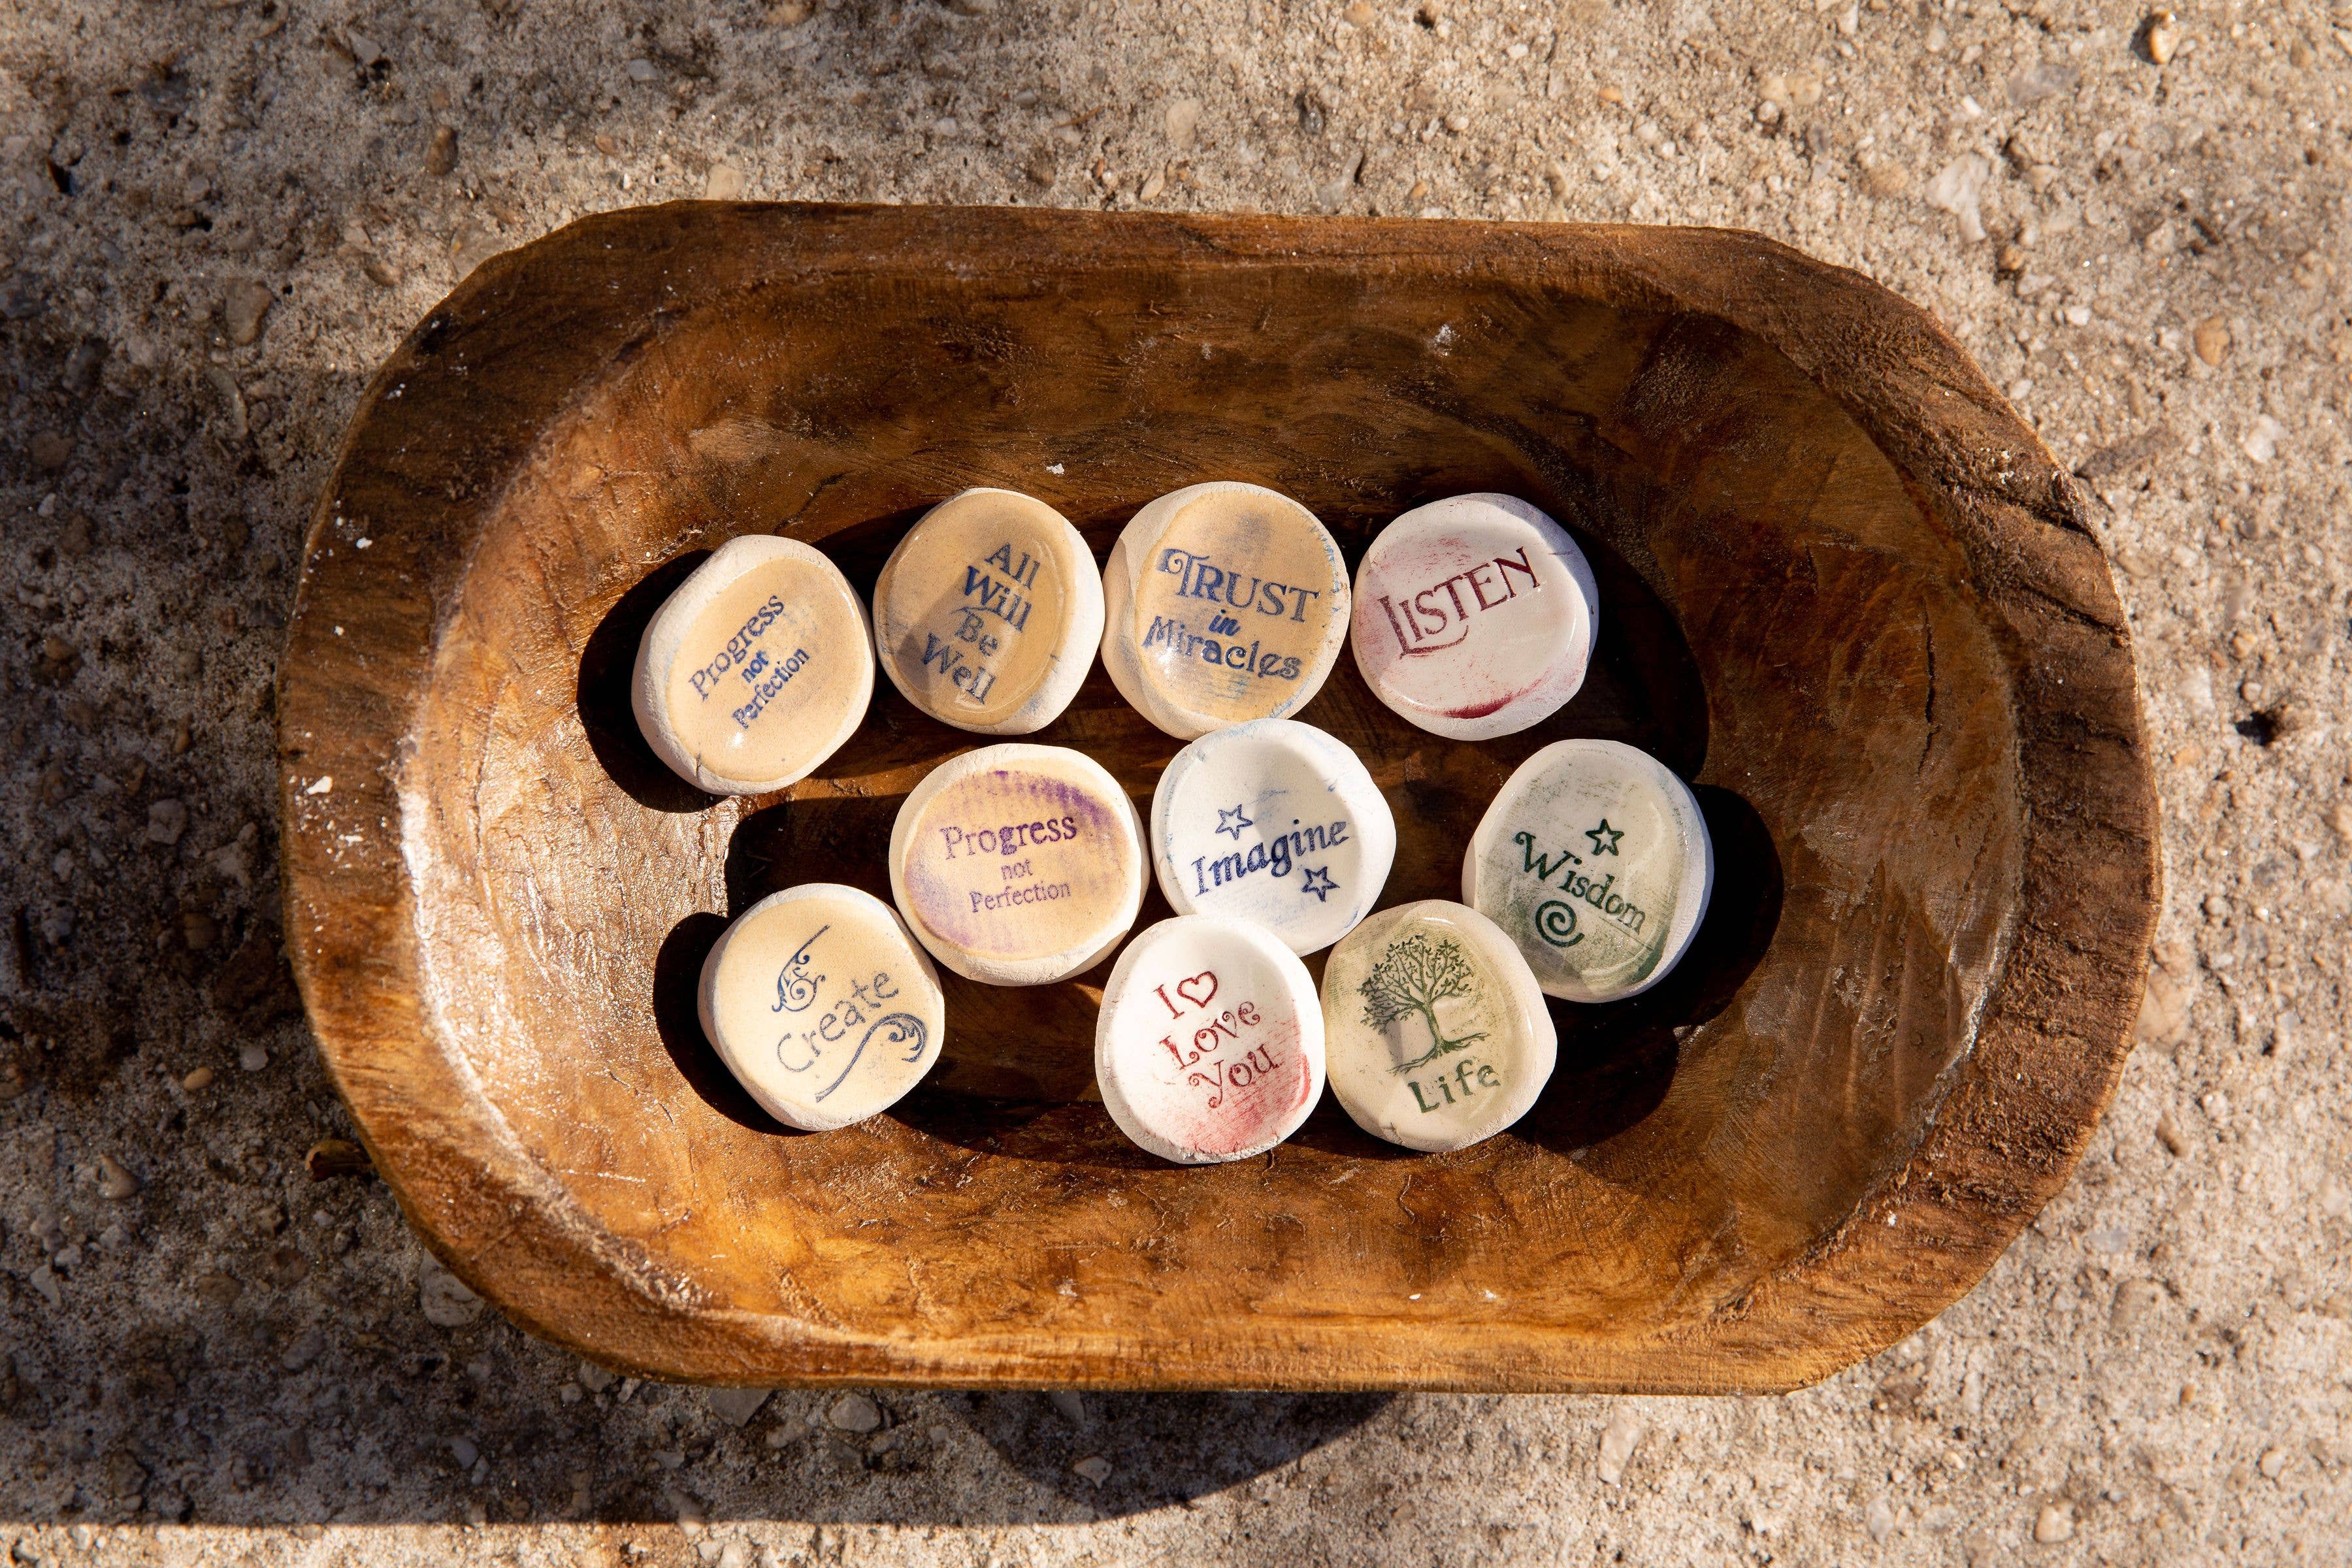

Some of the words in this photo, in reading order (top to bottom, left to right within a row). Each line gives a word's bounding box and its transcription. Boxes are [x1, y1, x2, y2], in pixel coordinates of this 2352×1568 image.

[984, 542, 1040, 591] All
[964, 565, 1032, 633] Will
[1208, 609, 1241, 636] in
[688, 595, 785, 701] Progress
[954, 610, 999, 657] Be
[1141, 615, 1301, 681] Miracles
[730, 647, 810, 729] Perfection
[741, 650, 770, 683] not
[921, 632, 996, 705] Well
[939, 815, 1077, 860] Progress
[1190, 817, 1350, 897] Imagine
[970, 881, 1071, 913] Perfection
[1001, 858, 1034, 880] not
[1514, 830, 1648, 936] Wisdom
[777, 971, 900, 1072] Create
[1153, 982, 1186, 1019] I
[1188, 1045, 1279, 1108] You
[1406, 1060, 1501, 1114] Life
